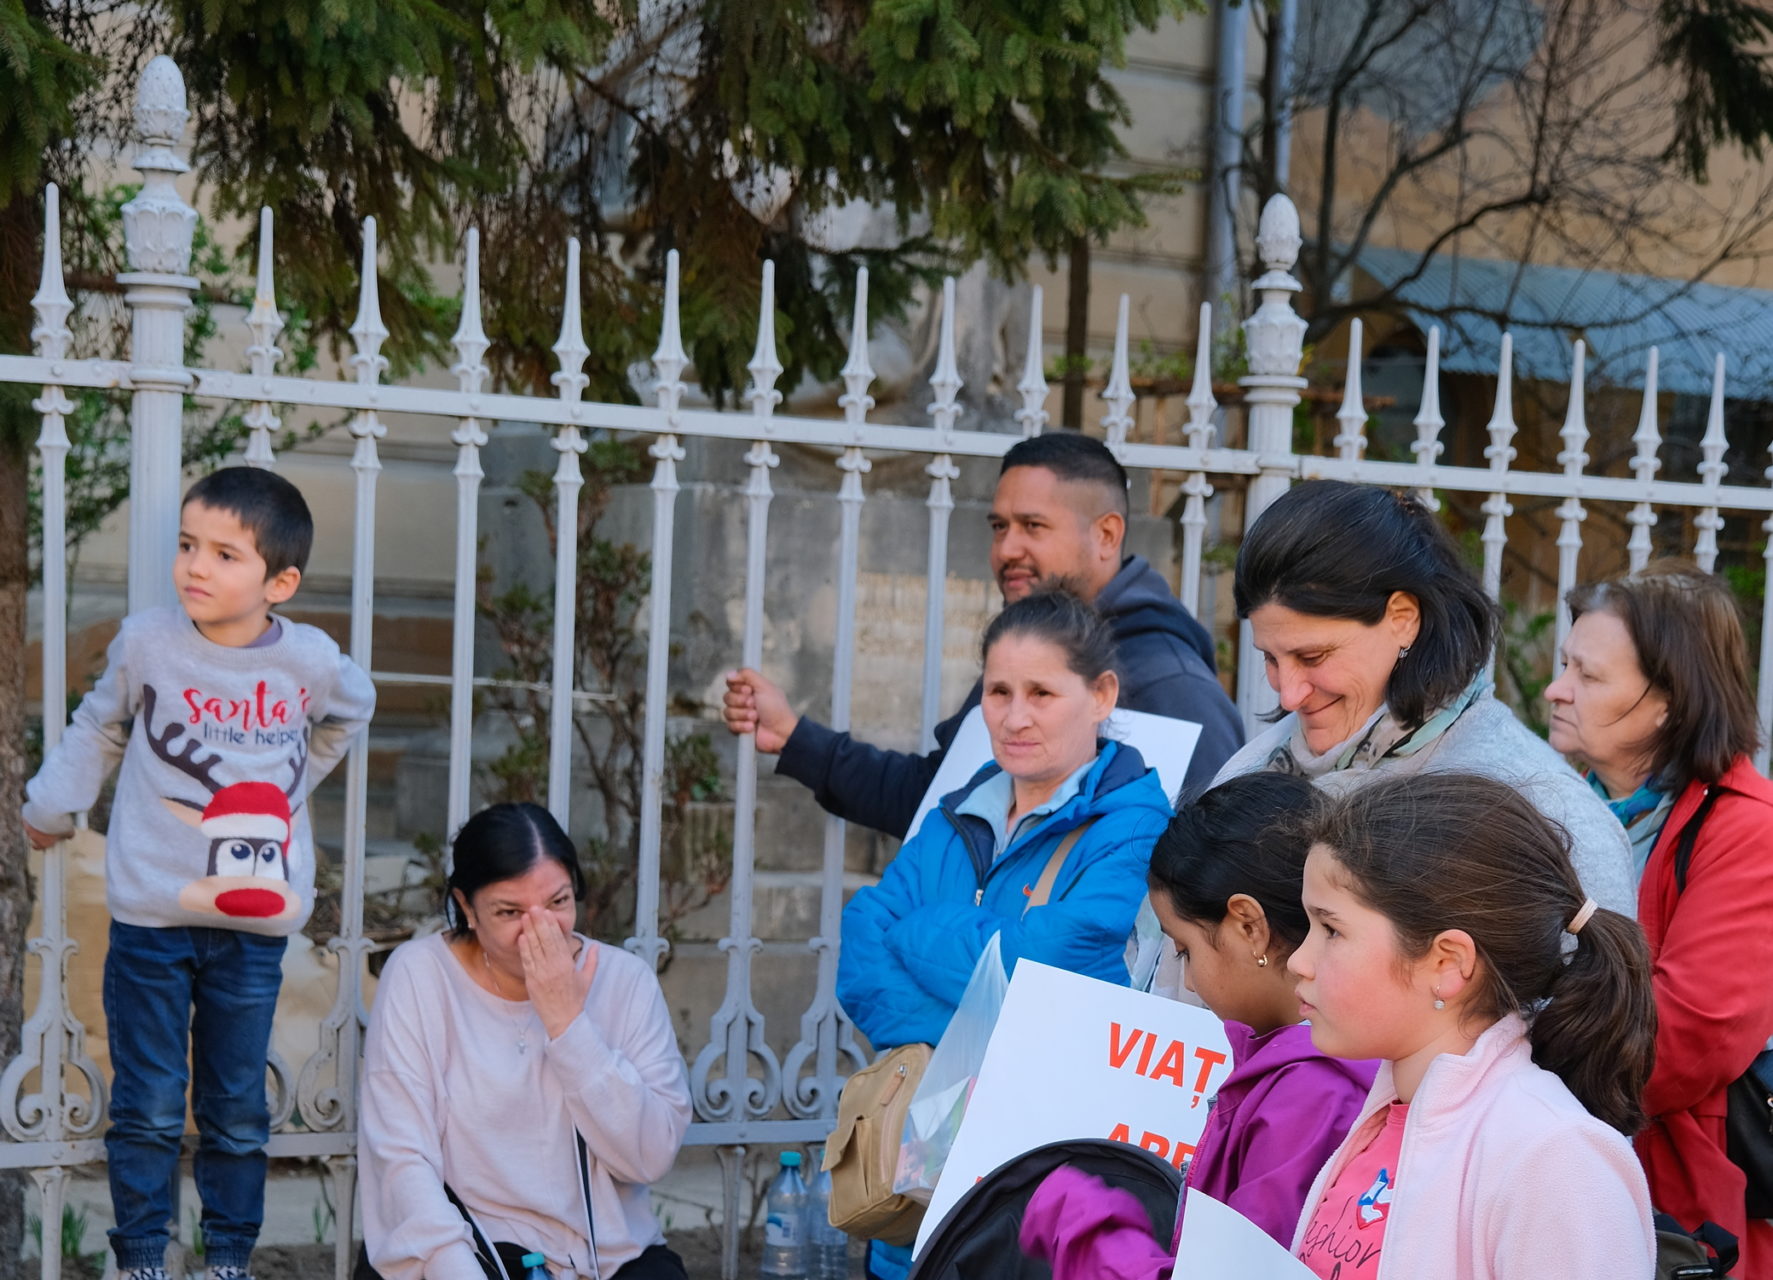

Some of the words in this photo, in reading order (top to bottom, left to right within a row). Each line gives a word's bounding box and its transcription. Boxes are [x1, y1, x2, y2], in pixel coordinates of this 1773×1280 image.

[204, 723, 245, 745] little
[254, 726, 299, 747] helpe
[1109, 1021, 1227, 1109] VIAȚ
